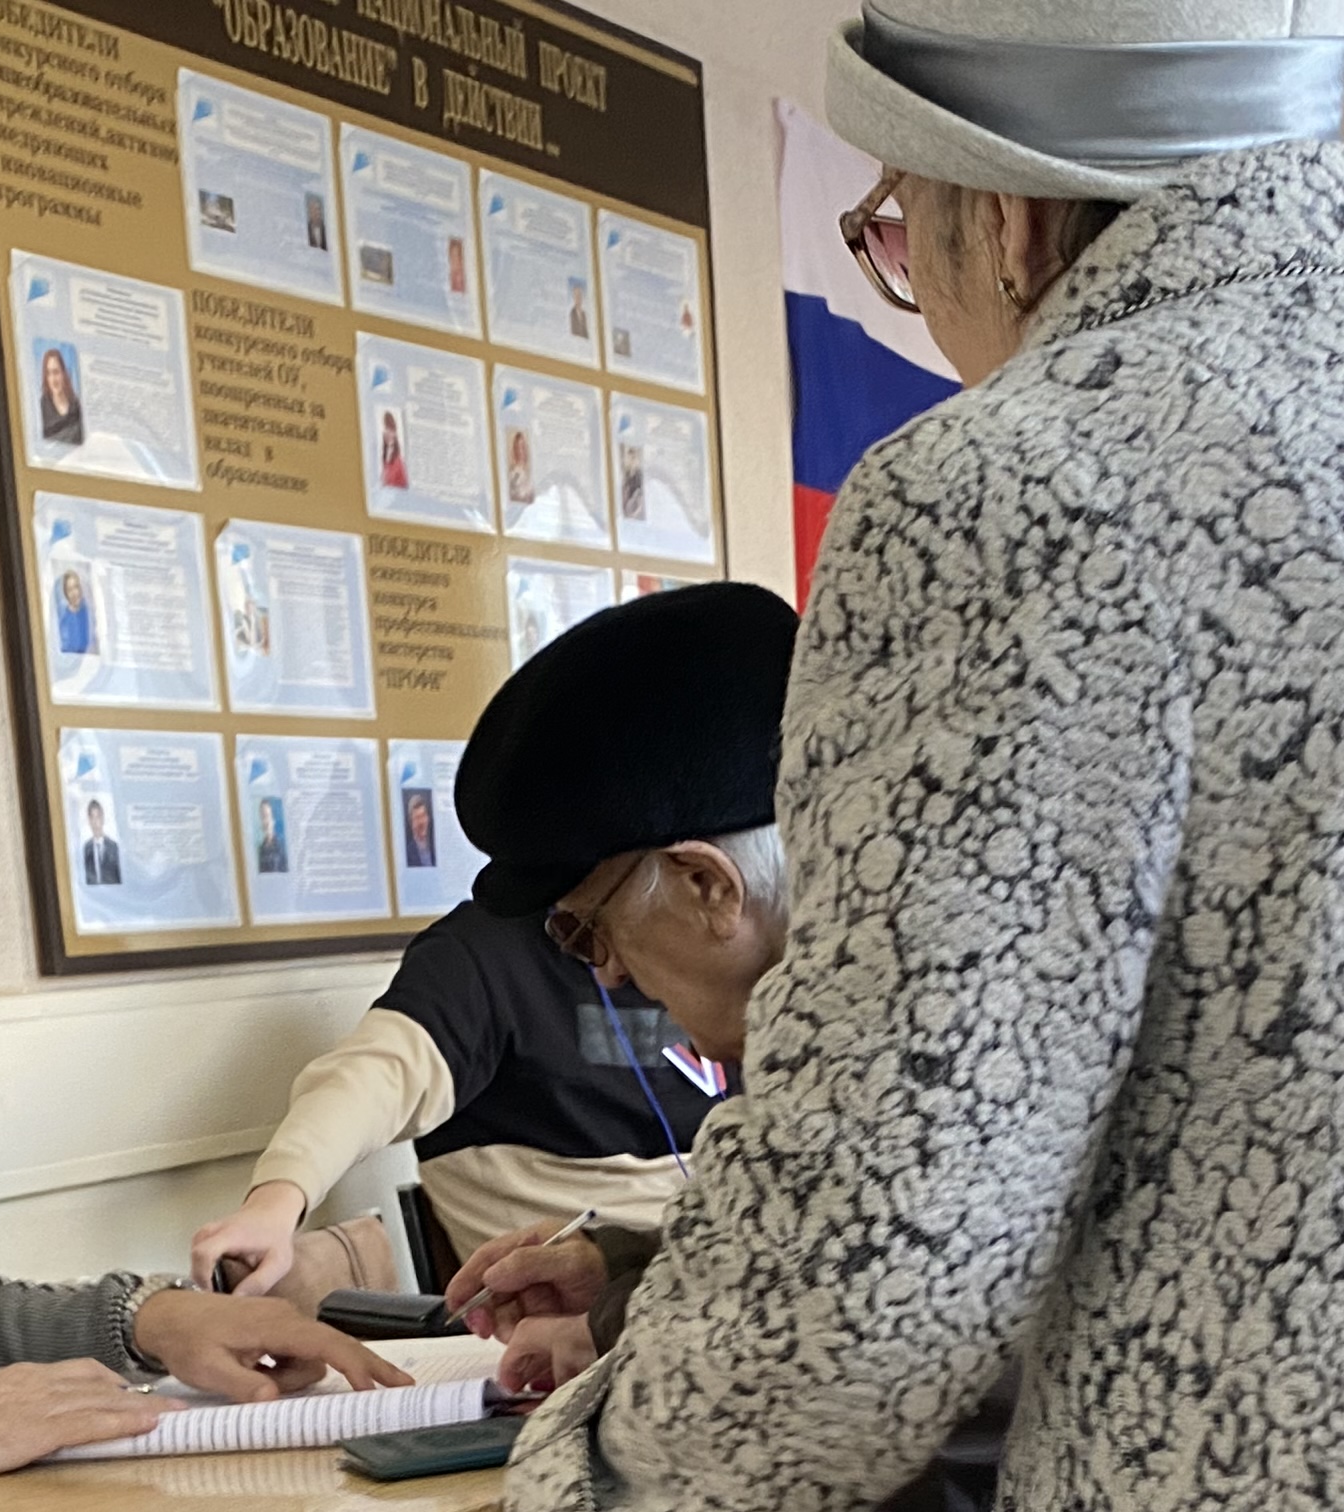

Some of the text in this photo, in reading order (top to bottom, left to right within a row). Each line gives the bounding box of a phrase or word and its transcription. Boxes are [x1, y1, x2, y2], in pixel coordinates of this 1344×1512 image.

[412, 56, 429, 109] В
[539, 40, 606, 113] ПРОЕКТ
[192, 289, 315, 339] ПОБЕДИТЕЛИ
[194, 324, 299, 360] конкурсного
